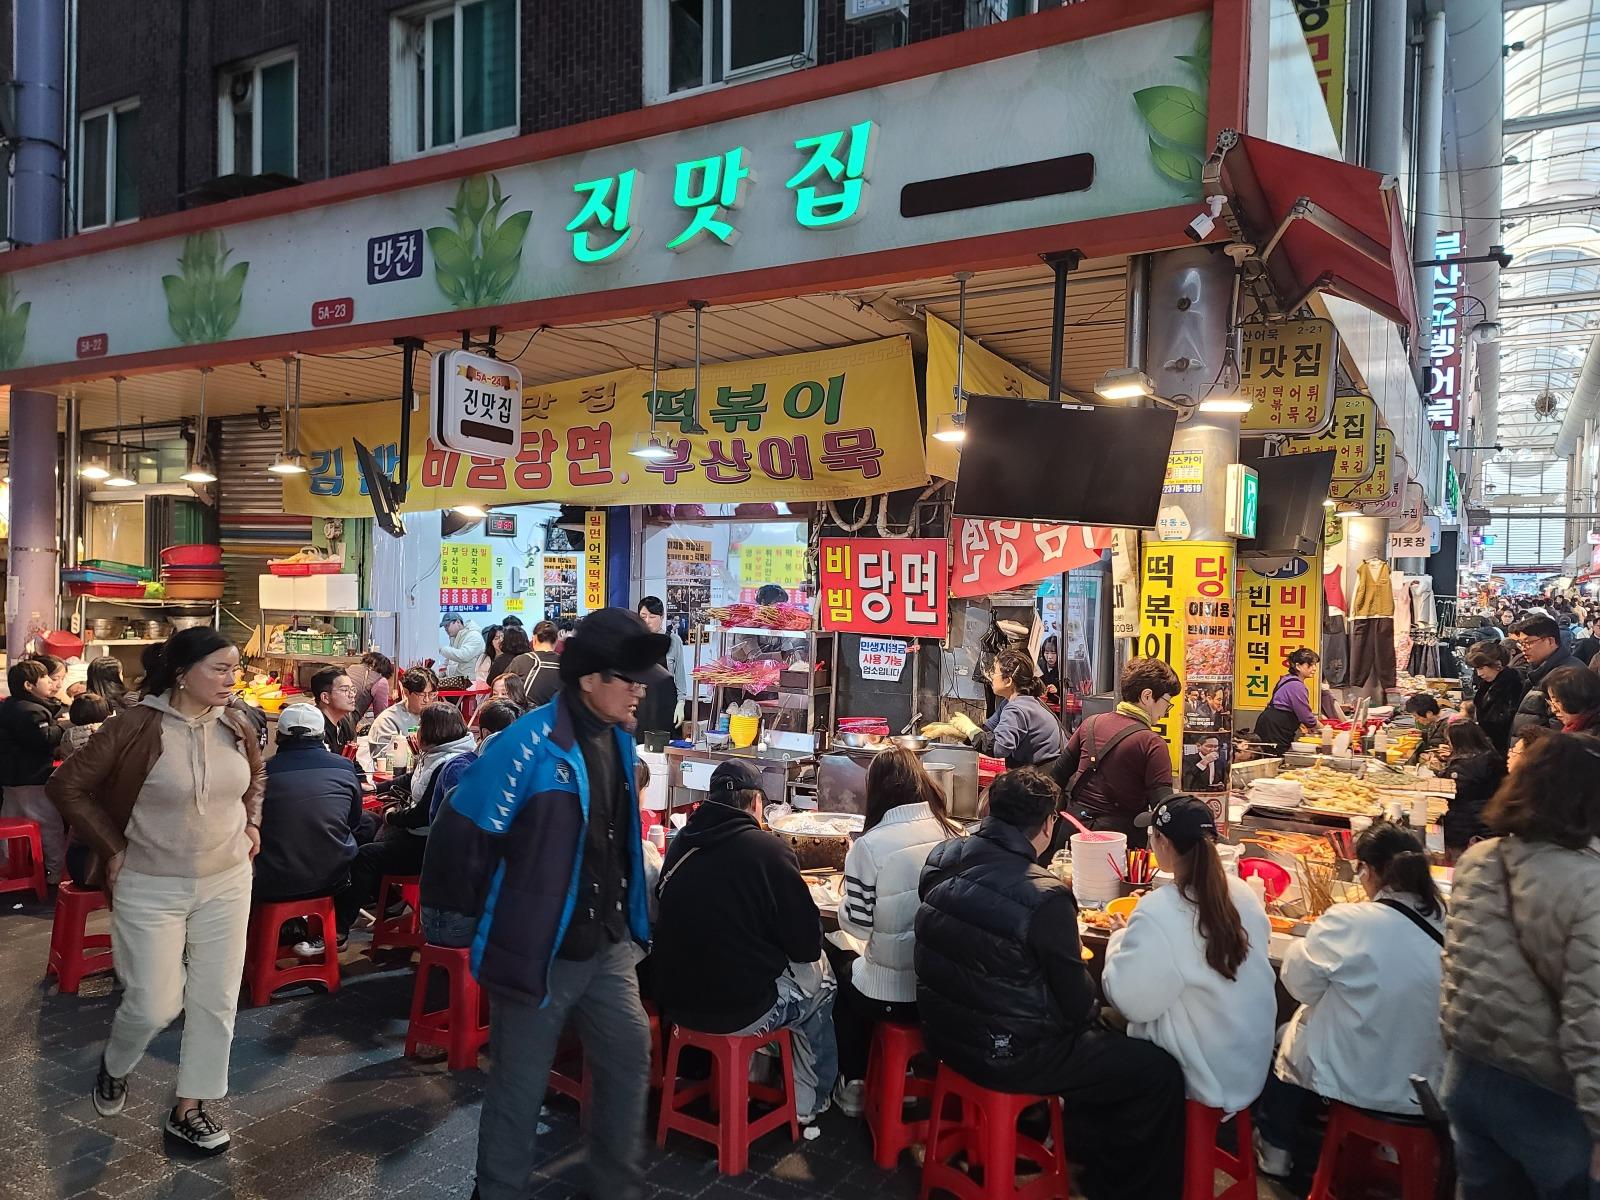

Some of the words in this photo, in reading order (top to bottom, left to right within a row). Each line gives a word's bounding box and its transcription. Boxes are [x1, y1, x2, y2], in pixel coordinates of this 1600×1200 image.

[565, 119, 877, 263] 진맛집
[373, 234, 417, 280] 반찬
[318, 303, 346, 320] 5A-23
[1297, 325, 1321, 335] 2-21
[80, 339, 102, 352] 5A-22
[475, 371, 501, 386] 5A-24
[463, 387, 512, 424] 진맛집
[642, 372, 846, 434] 떡볶이
[1271, 385, 1283, 424] 떡볶이
[1287, 384, 1301, 423] 어묵
[1305, 384, 1319, 423] 튀김
[644, 427, 885, 485] 부산어묵
[825, 545, 853, 623] 비빔
[858, 549, 939, 624] 당면
[1145, 554, 1175, 667] 떡볶이
[860, 641, 907, 654] 민생지원금
[863, 654, 881, 665] 사용
[884, 655, 903, 667] 가능
[863, 666, 899, 677] 업소입니다
